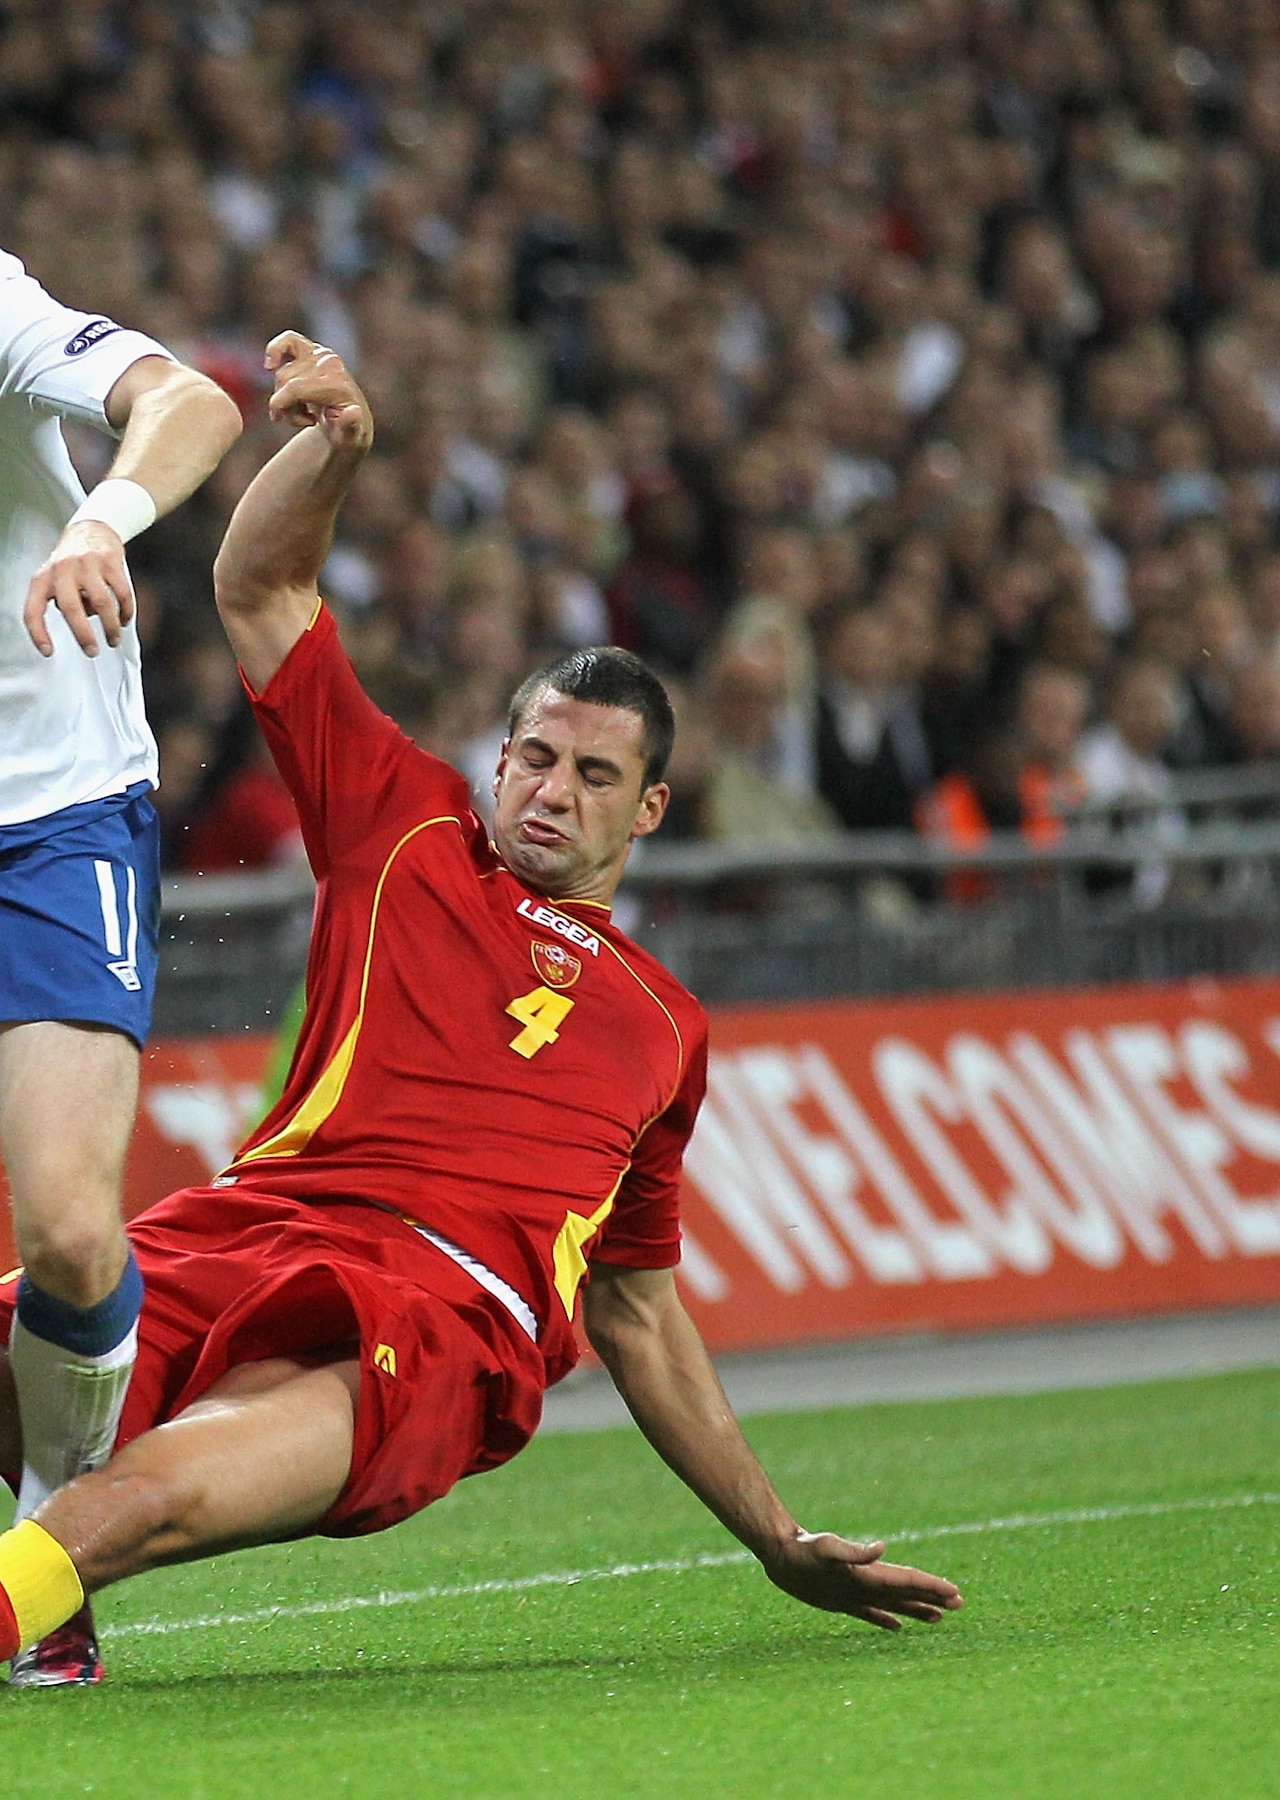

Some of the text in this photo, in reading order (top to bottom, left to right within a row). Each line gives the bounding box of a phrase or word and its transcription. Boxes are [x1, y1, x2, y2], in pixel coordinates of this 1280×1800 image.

[93, 859, 138, 968] 11
[516, 898, 600, 957] LEGEA
[505, 986, 576, 1060] 4
